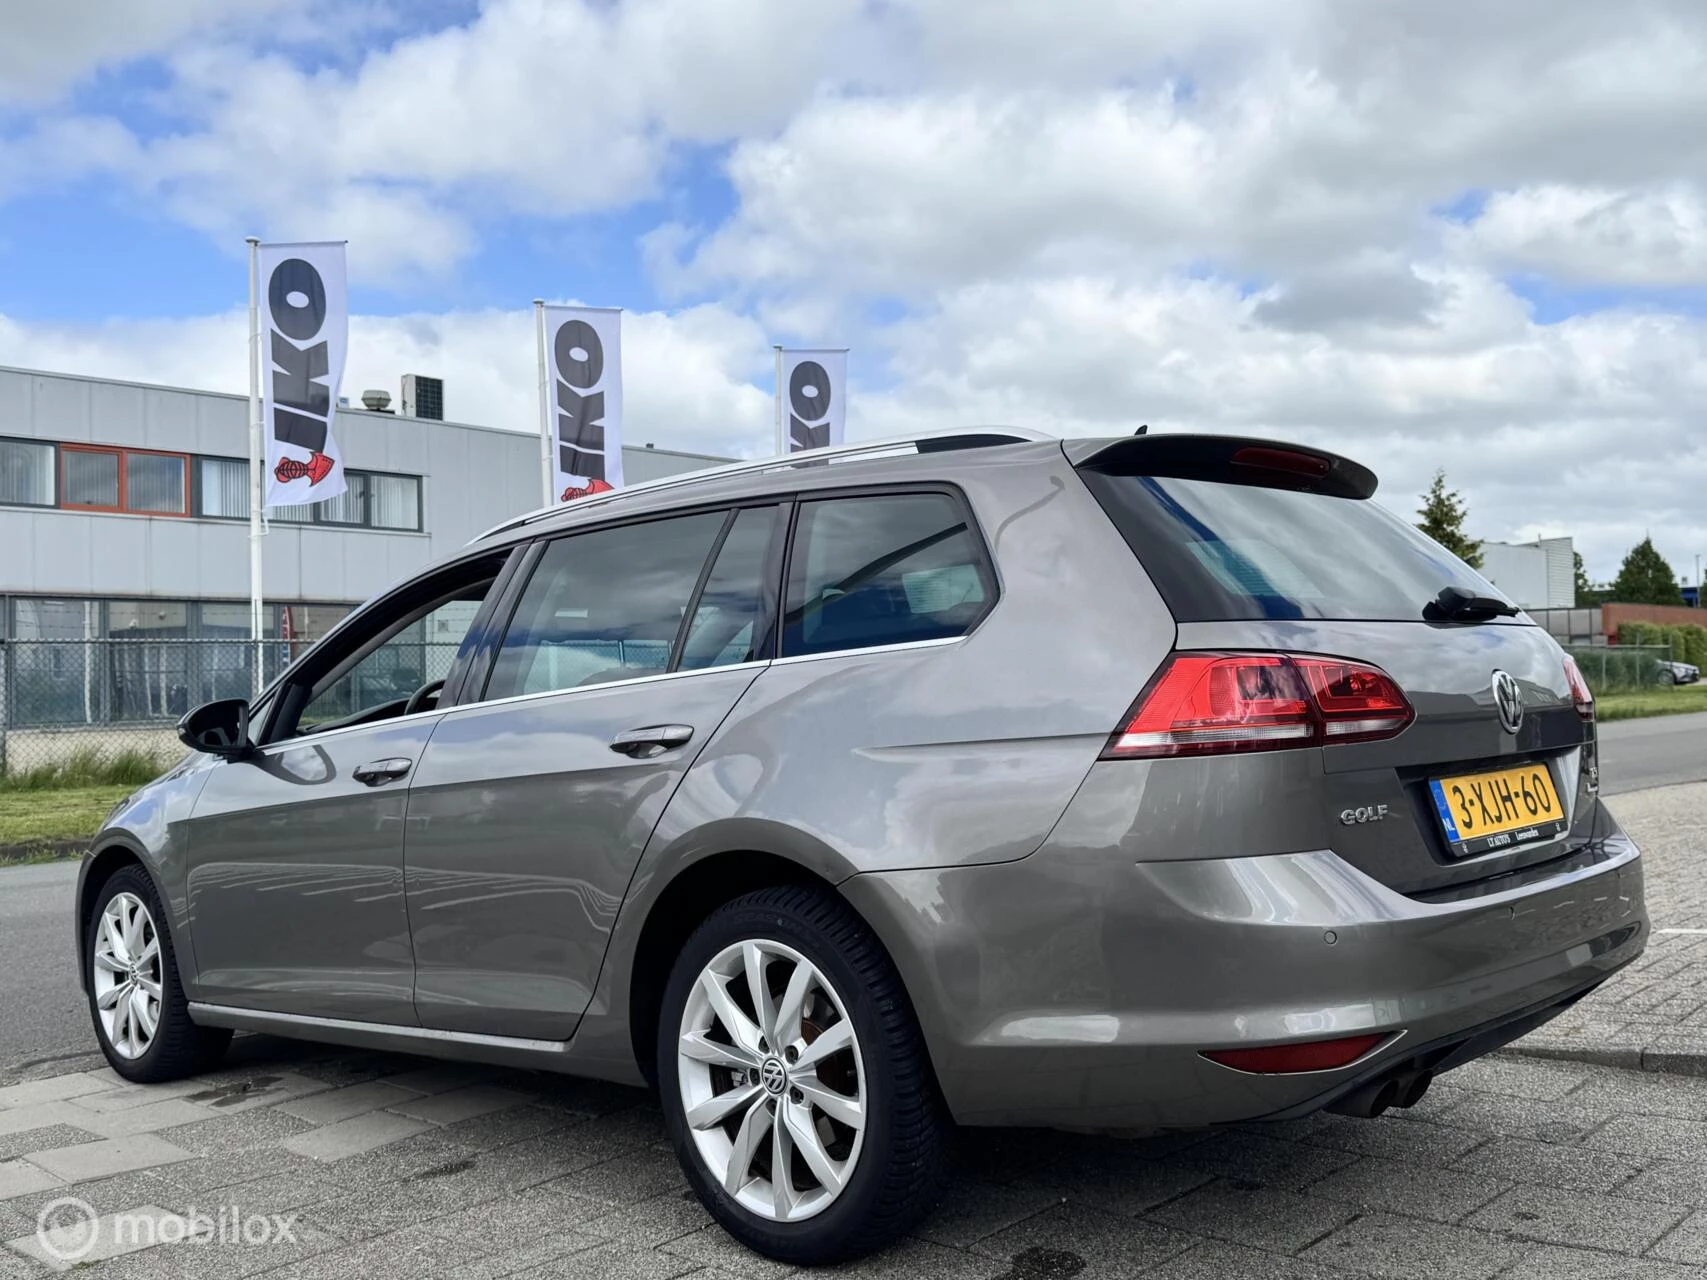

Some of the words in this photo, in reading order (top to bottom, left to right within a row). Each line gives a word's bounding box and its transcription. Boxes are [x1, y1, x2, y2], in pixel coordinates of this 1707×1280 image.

[269, 258, 330, 454] IKO
[554, 319, 606, 481] IKO
[789, 360, 831, 469] KO
[1340, 804, 1388, 825] GOLF
[1442, 817, 1456, 832] NL
[1452, 773, 1551, 829] 3-XJH-60
